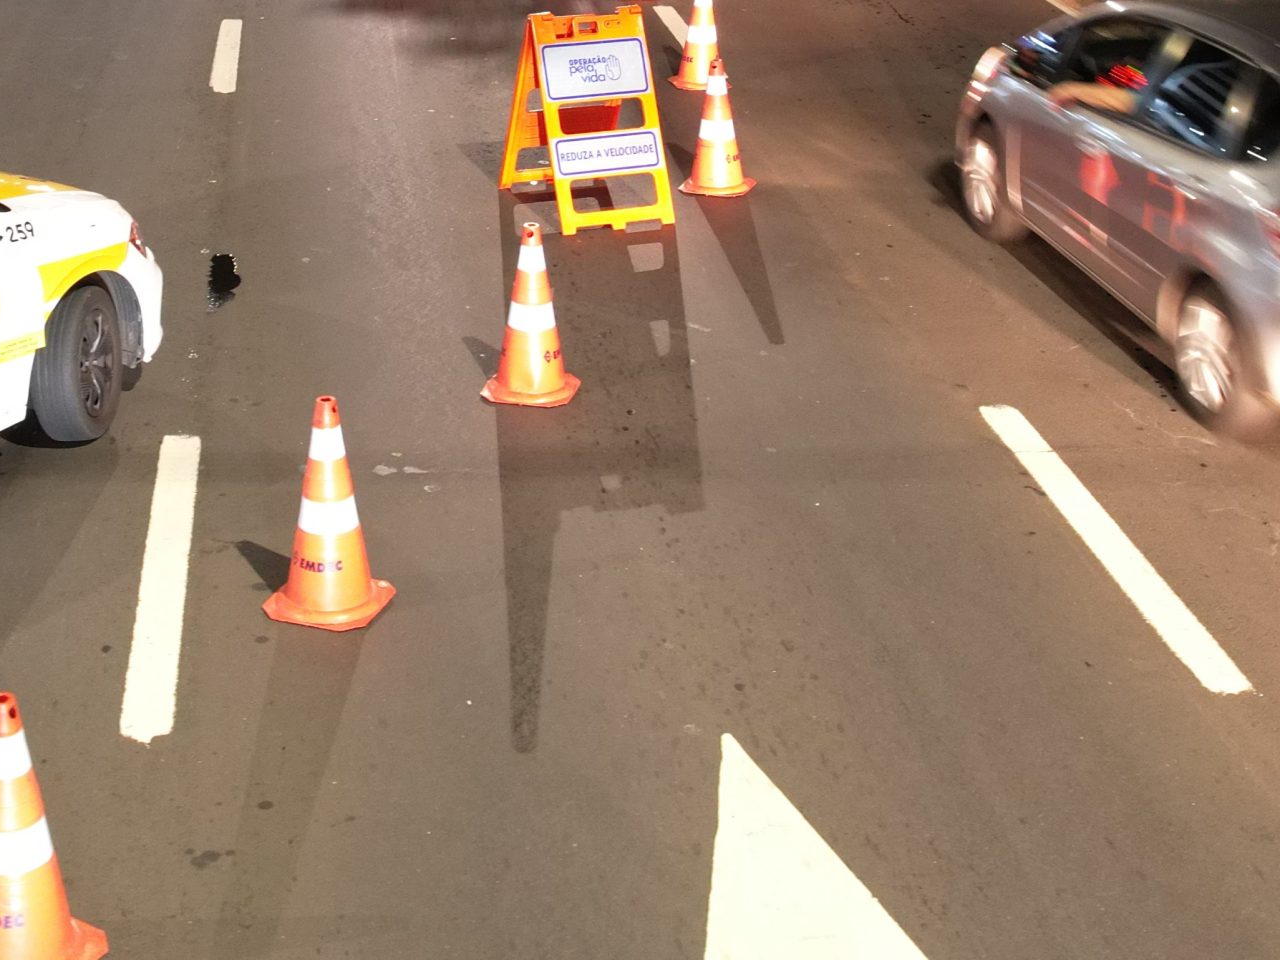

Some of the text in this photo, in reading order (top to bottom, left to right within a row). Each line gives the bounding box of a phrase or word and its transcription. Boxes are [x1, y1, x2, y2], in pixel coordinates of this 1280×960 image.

[569, 56, 607, 65] OPERAÇÃO
[569, 63, 595, 76] pela
[581, 70, 606, 83] vida
[560, 144, 654, 162] REDUZA A VELOCIDADE
[6, 221, 35, 243] 259
